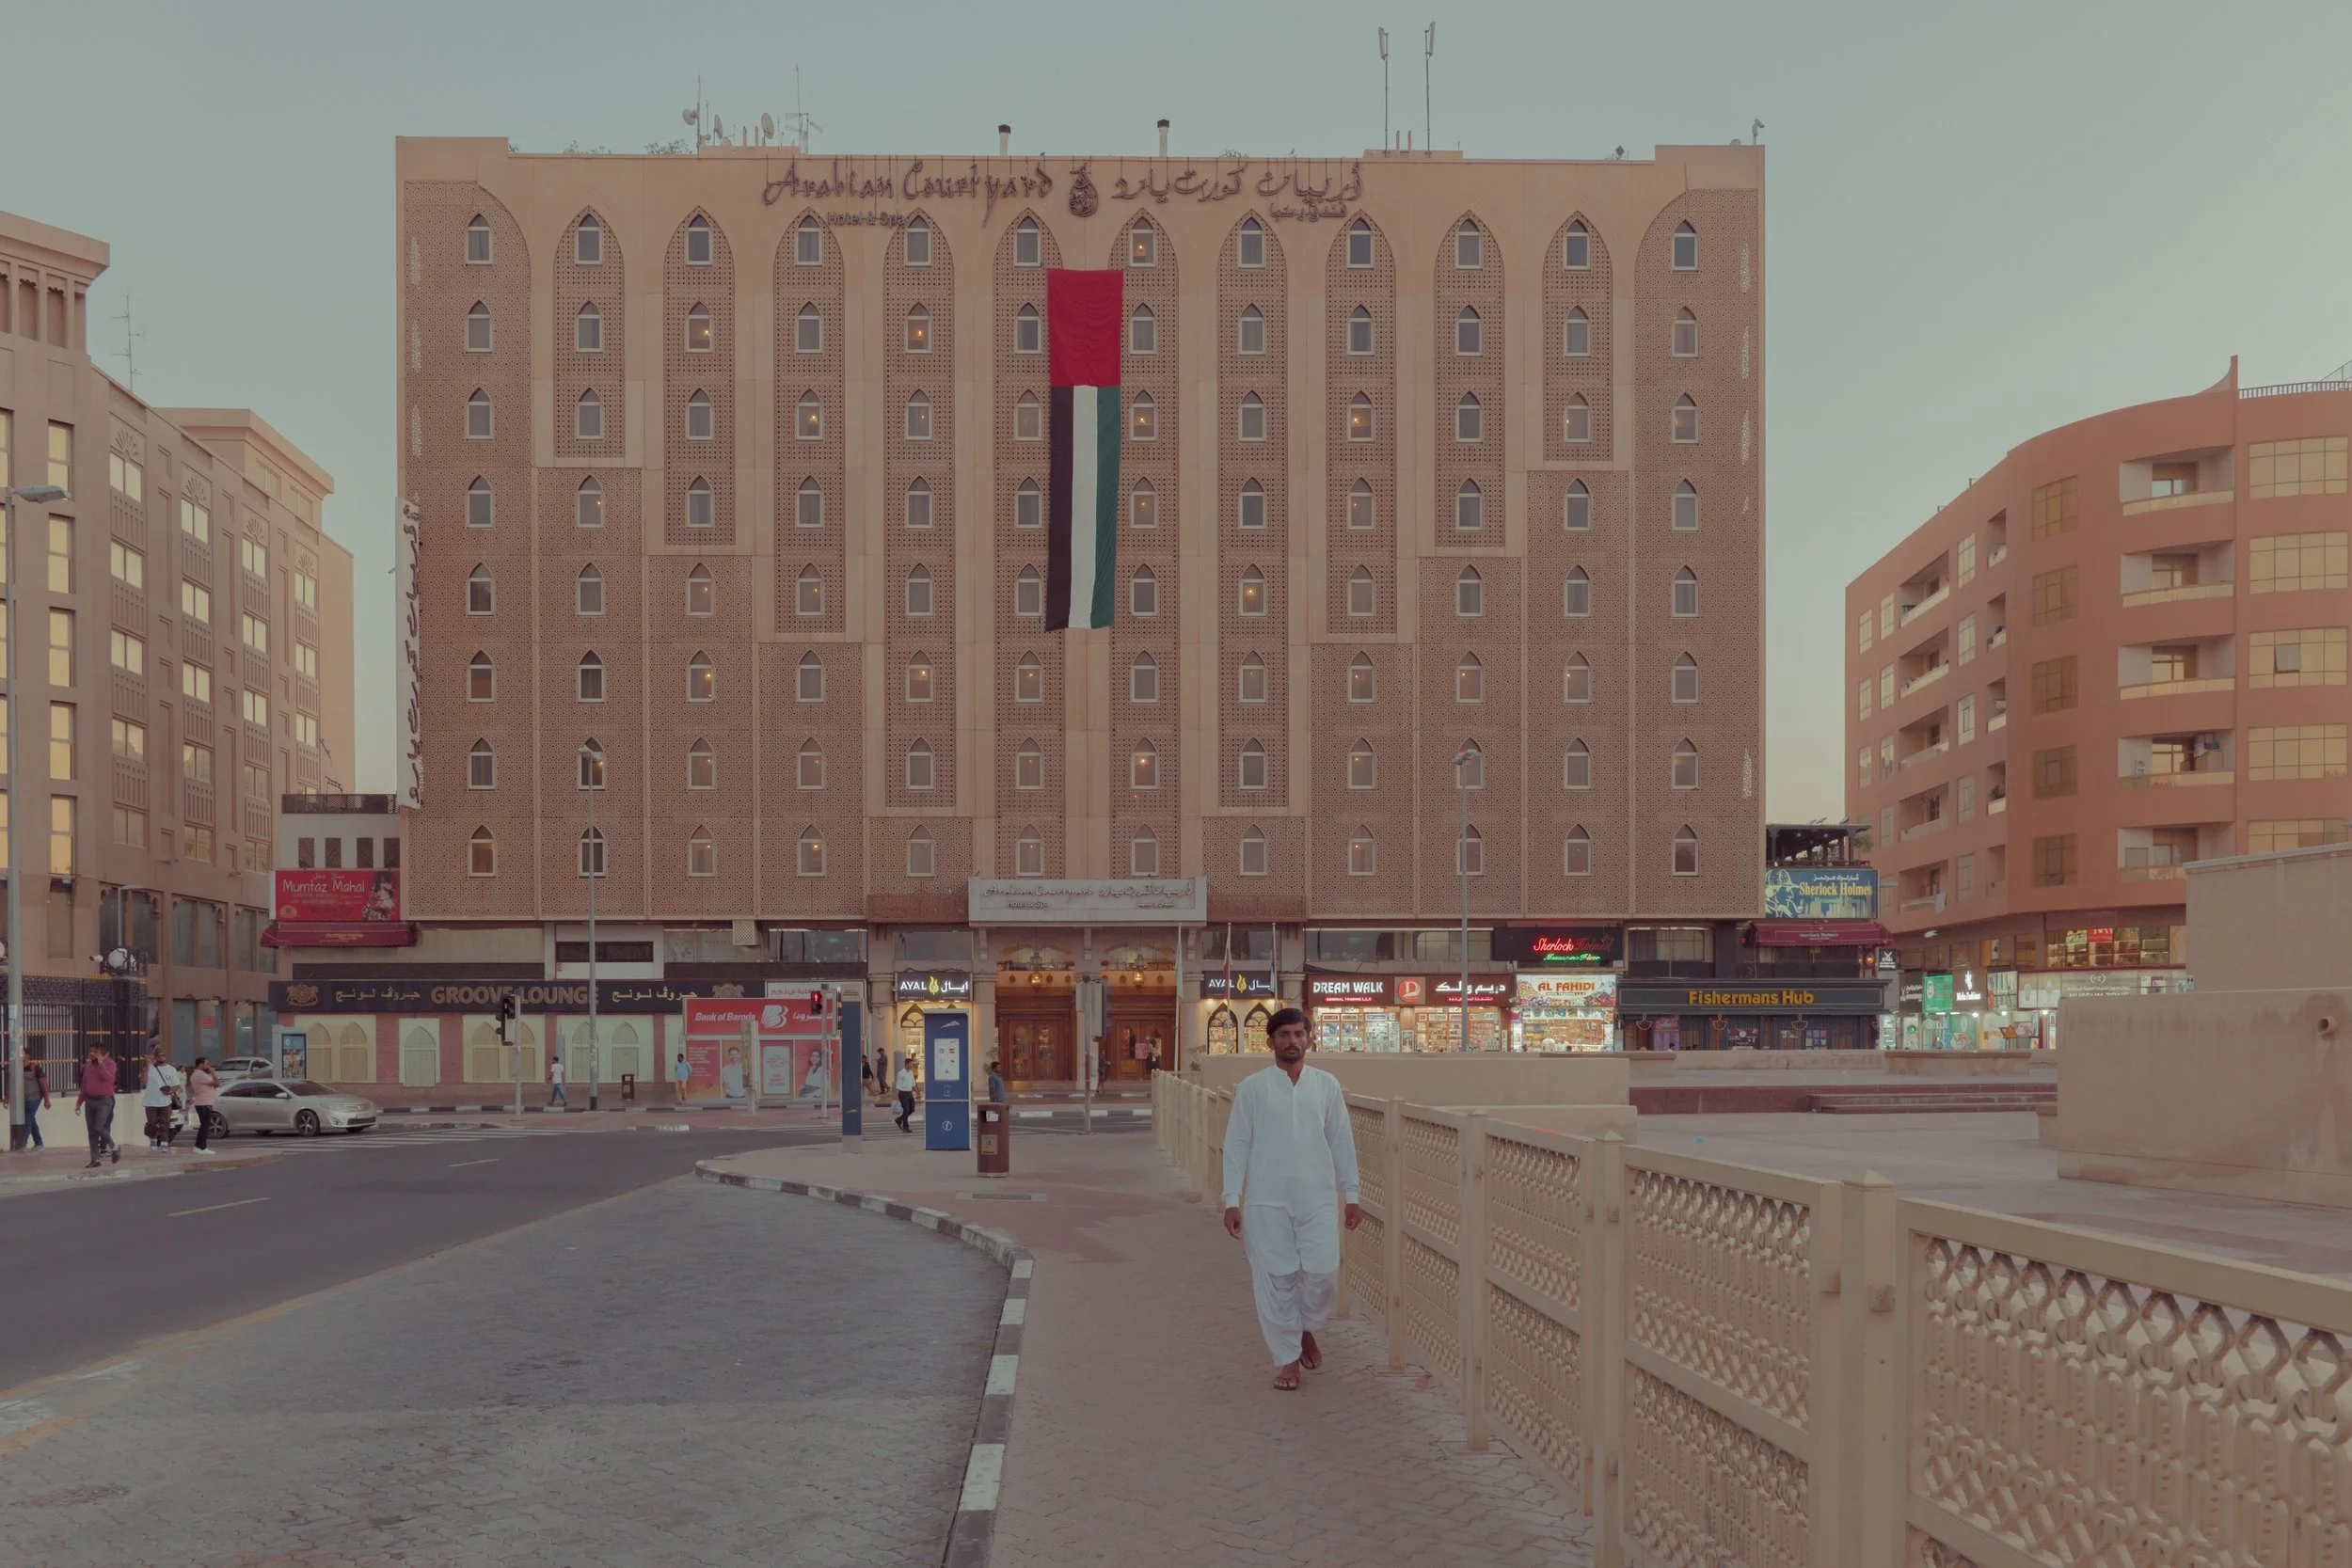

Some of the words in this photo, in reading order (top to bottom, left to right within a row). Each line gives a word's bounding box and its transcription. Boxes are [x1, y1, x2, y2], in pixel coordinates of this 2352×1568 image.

[763, 161, 894, 205] Arabian
[827, 211, 863, 226] Hotel
[866, 211, 877, 226] &
[879, 211, 908, 229] Spa
[283, 879, 328, 893] Mumtaz
[332, 879, 365, 893] Mahal
[1799, 881, 1837, 896] Sherlock
[1840, 882, 1872, 896] Holmes
[1534, 937, 1575, 952] Sherlock
[899, 981, 927, 990] AYAL
[1313, 981, 1350, 994] DREAM
[1353, 981, 1384, 994] WALK
[1537, 982, 1552, 991] AL
[1556, 982, 1596, 991] FAHIDI
[1689, 990, 1778, 1006] Fishermans
[1782, 990, 1814, 1005] Hub
[695, 1011, 718, 1022] Bank
[718, 1011, 726, 1022] of
[726, 1011, 755, 1022] Baroda
